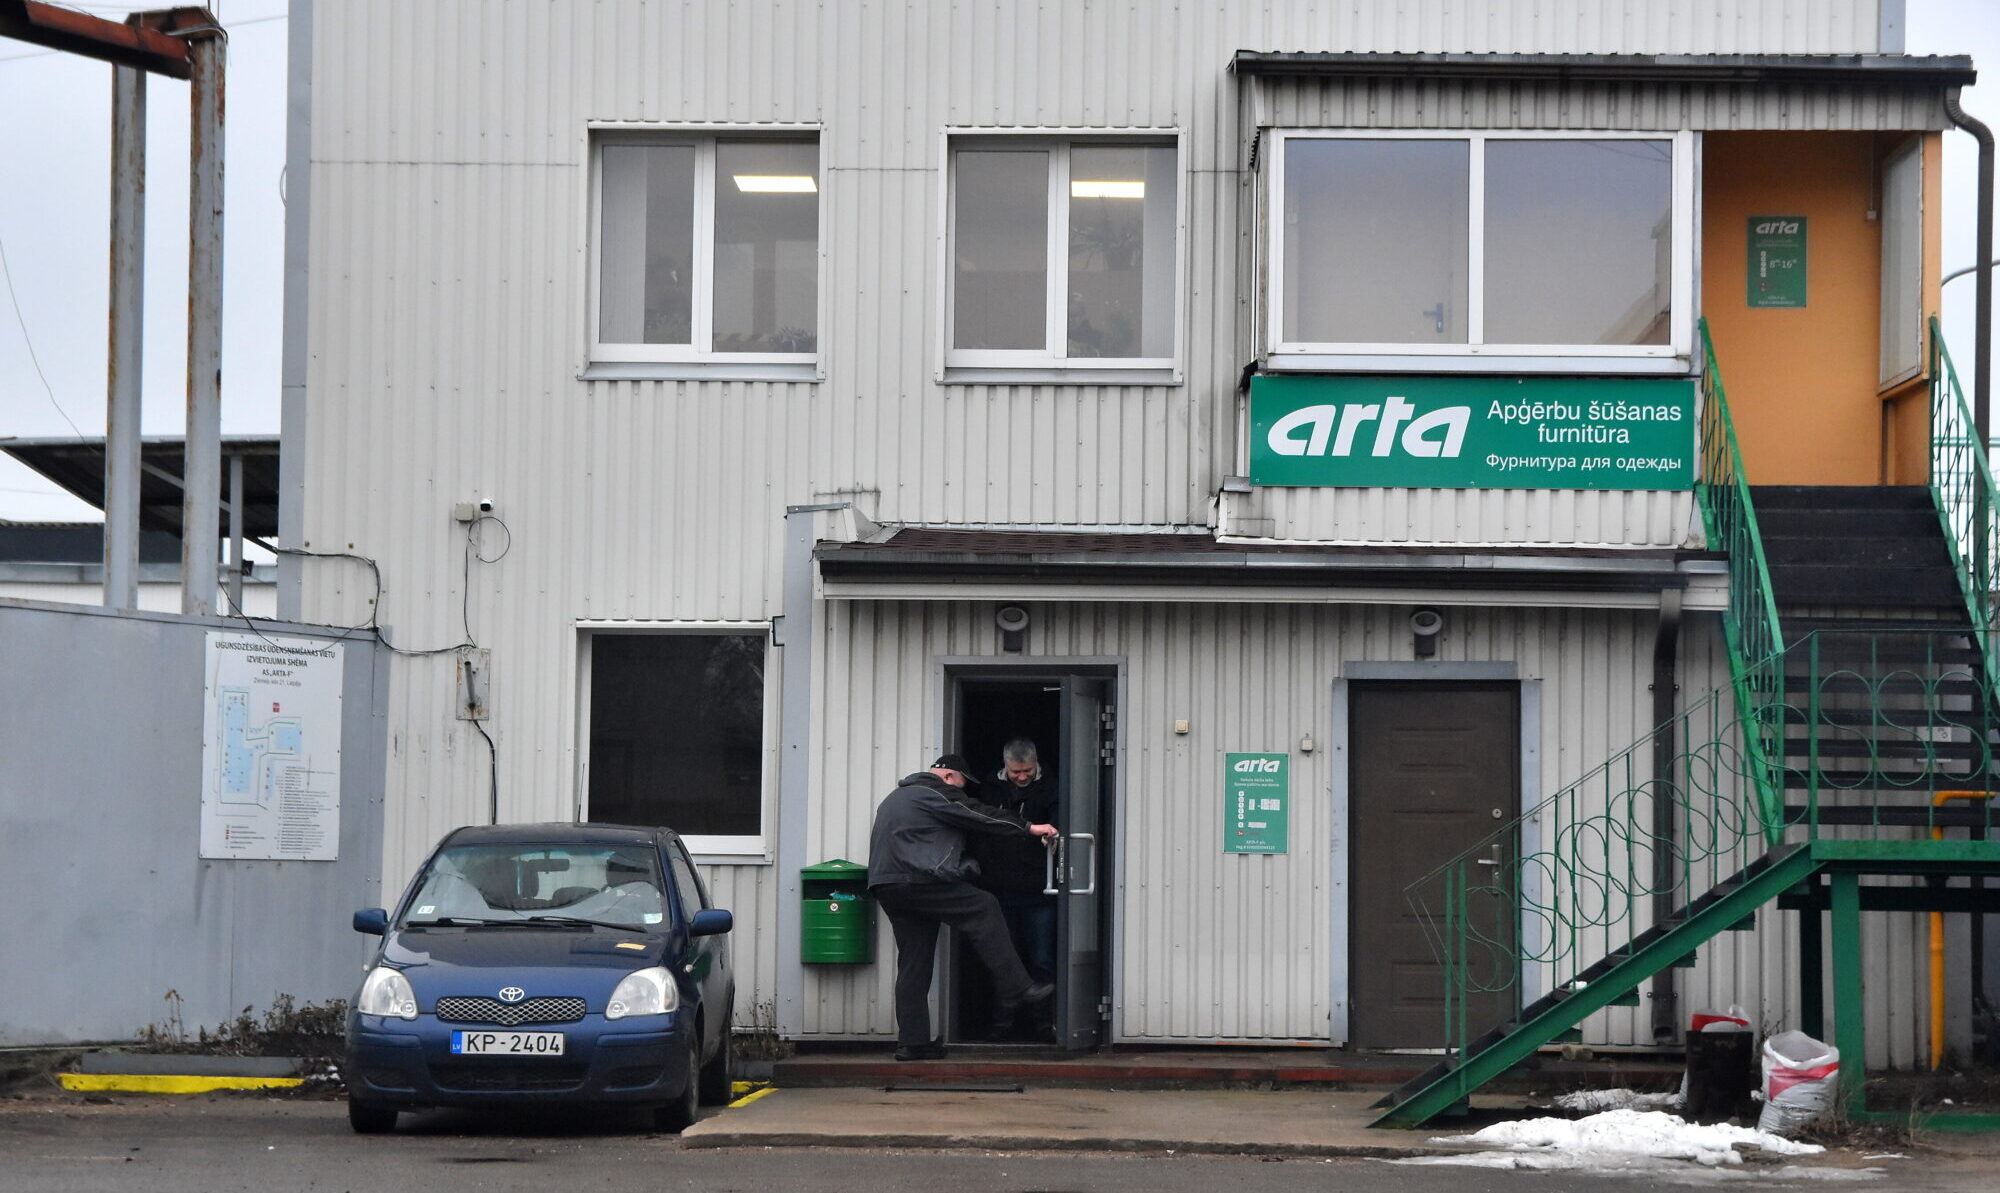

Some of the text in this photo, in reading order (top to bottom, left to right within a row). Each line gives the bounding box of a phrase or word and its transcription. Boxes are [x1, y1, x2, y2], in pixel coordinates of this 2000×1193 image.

[1756, 221, 1799, 234] arta
[1487, 398, 1682, 425] Apģērbu šūšanas
[1267, 396, 1471, 458] arta
[1538, 423, 1630, 444] furnitūra
[1486, 453, 1681, 472] Фурнитура для одежды
[246, 655, 287, 665] IZVIETOJUMA
[1234, 758, 1280, 772] arta
[467, 1034, 560, 1053] KP-2404
